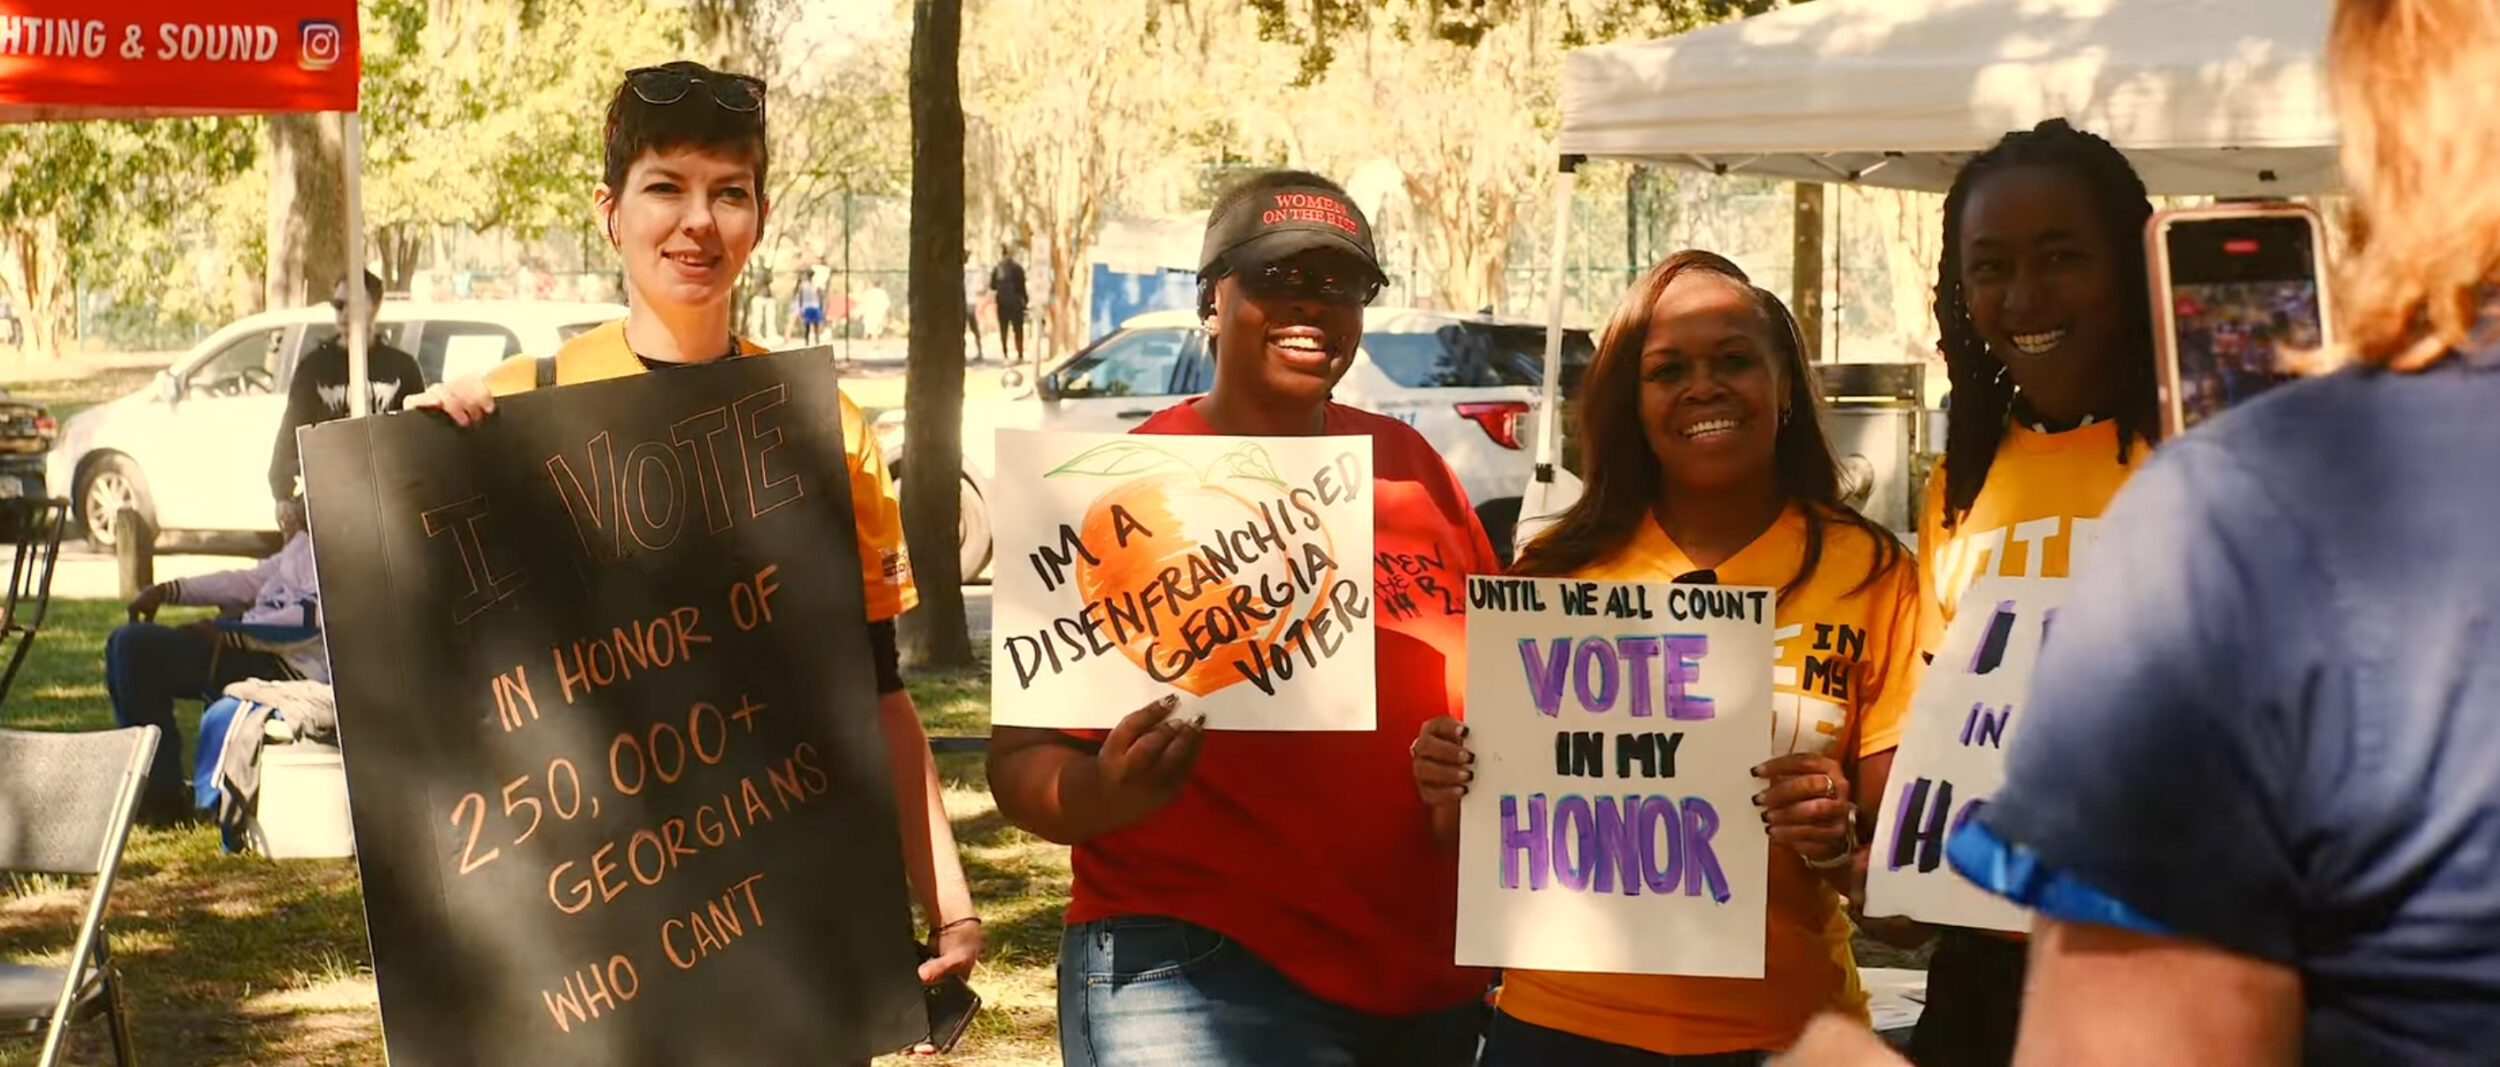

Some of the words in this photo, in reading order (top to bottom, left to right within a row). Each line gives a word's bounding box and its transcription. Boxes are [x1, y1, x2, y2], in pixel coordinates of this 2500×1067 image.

[119, 23, 146, 60] &
[156, 22, 279, 61] SOUND
[1263, 209, 1288, 224] ON
[1290, 208, 1325, 222] THE
[1326, 213, 1357, 234] RISE
[1275, 193, 1347, 214] WOMEN
[421, 494, 531, 625] I
[546, 383, 804, 558] VOTE
[1029, 523, 1101, 592] IM
[1111, 503, 1152, 548] A
[1003, 450, 1364, 690] DISENFRANCHISED
[1144, 542, 1339, 684] GEORGIA
[1468, 578, 1547, 613] UNTIL
[1560, 582, 1599, 617] WE
[1604, 584, 1654, 620] ALL
[1669, 588, 1769, 625] COUNT
[491, 664, 539, 733] IN
[551, 605, 712, 704] HONOR
[728, 563, 781, 632] OF
[1233, 577, 1370, 697] VOTER
[1517, 632, 1716, 720] VOTE
[1802, 655, 1850, 701] MY
[1812, 622, 1867, 664] IN
[1555, 731, 1603, 778] IN
[1616, 731, 1685, 779] MY
[1959, 701, 2012, 750] IN
[450, 692, 768, 876] 250,000+
[547, 740, 829, 916] GEORGIANS
[1500, 792, 1732, 905] HONOR
[541, 953, 641, 1033] WHO
